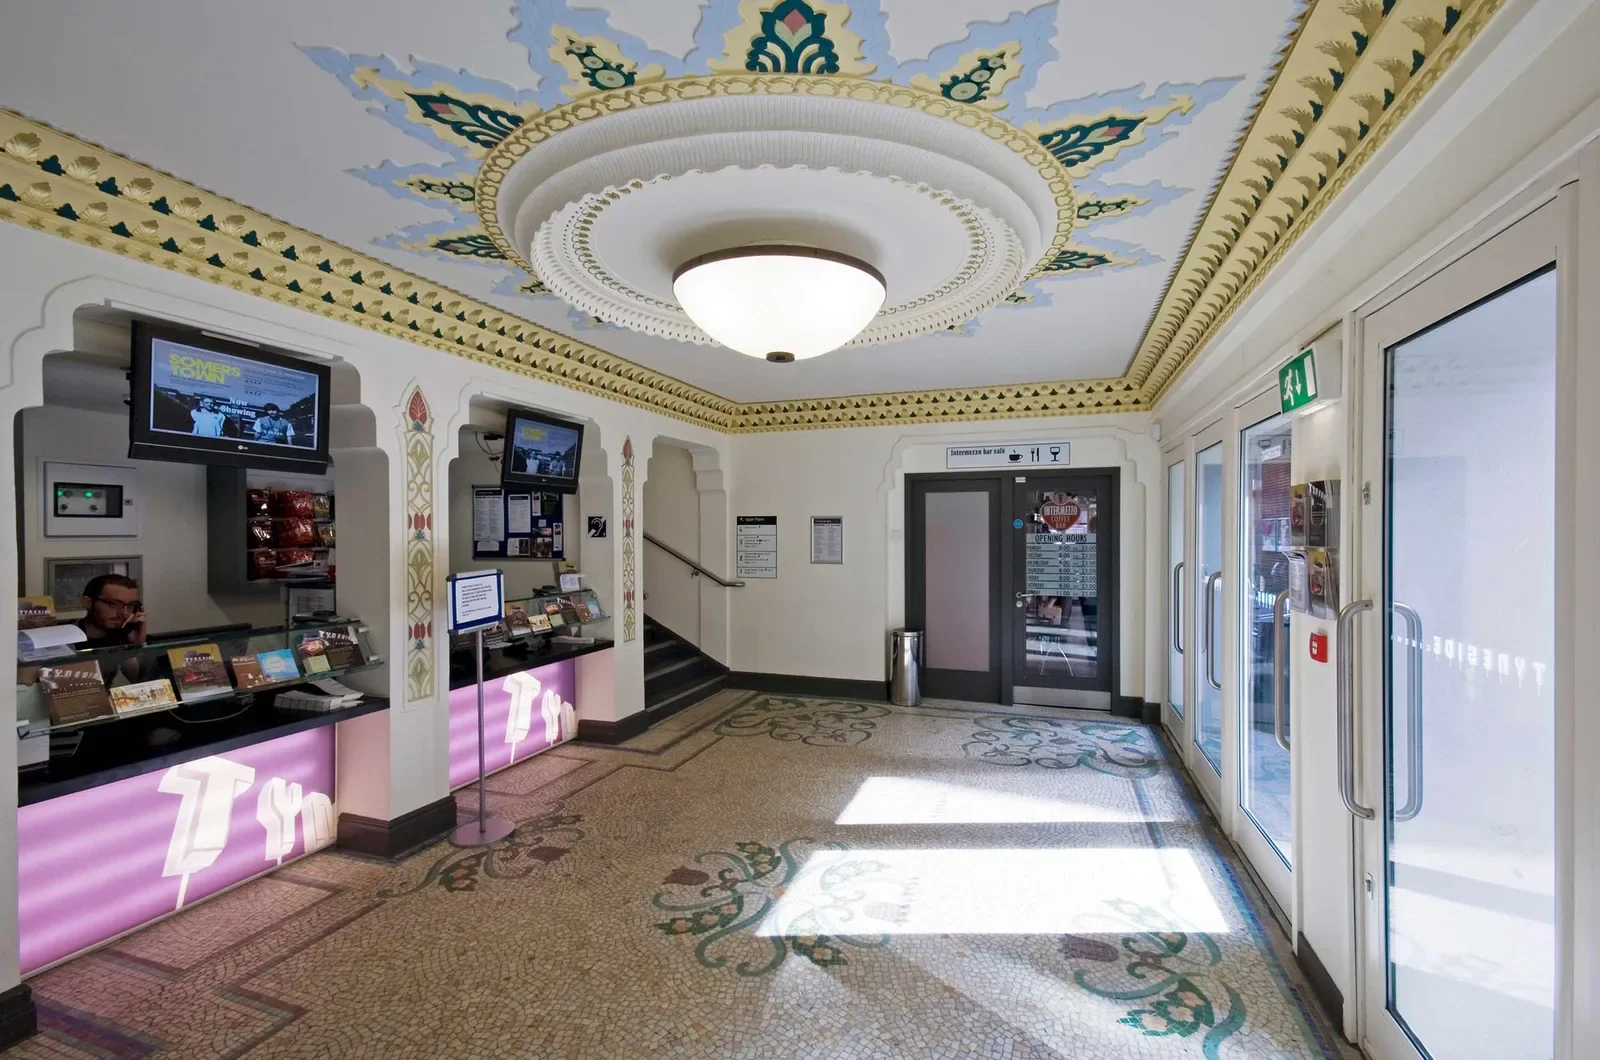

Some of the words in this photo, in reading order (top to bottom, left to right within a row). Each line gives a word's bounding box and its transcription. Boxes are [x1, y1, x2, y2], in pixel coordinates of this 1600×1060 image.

[169, 352, 241, 377] SOMERS
[171, 365, 226, 384] TOWN
[229, 396, 248, 407] Now
[219, 404, 257, 418] Showing
[1044, 506, 1078, 515] INTERMEZZO
[1035, 534, 1063, 543] OPENING
[1066, 534, 1087, 542] HOURS
